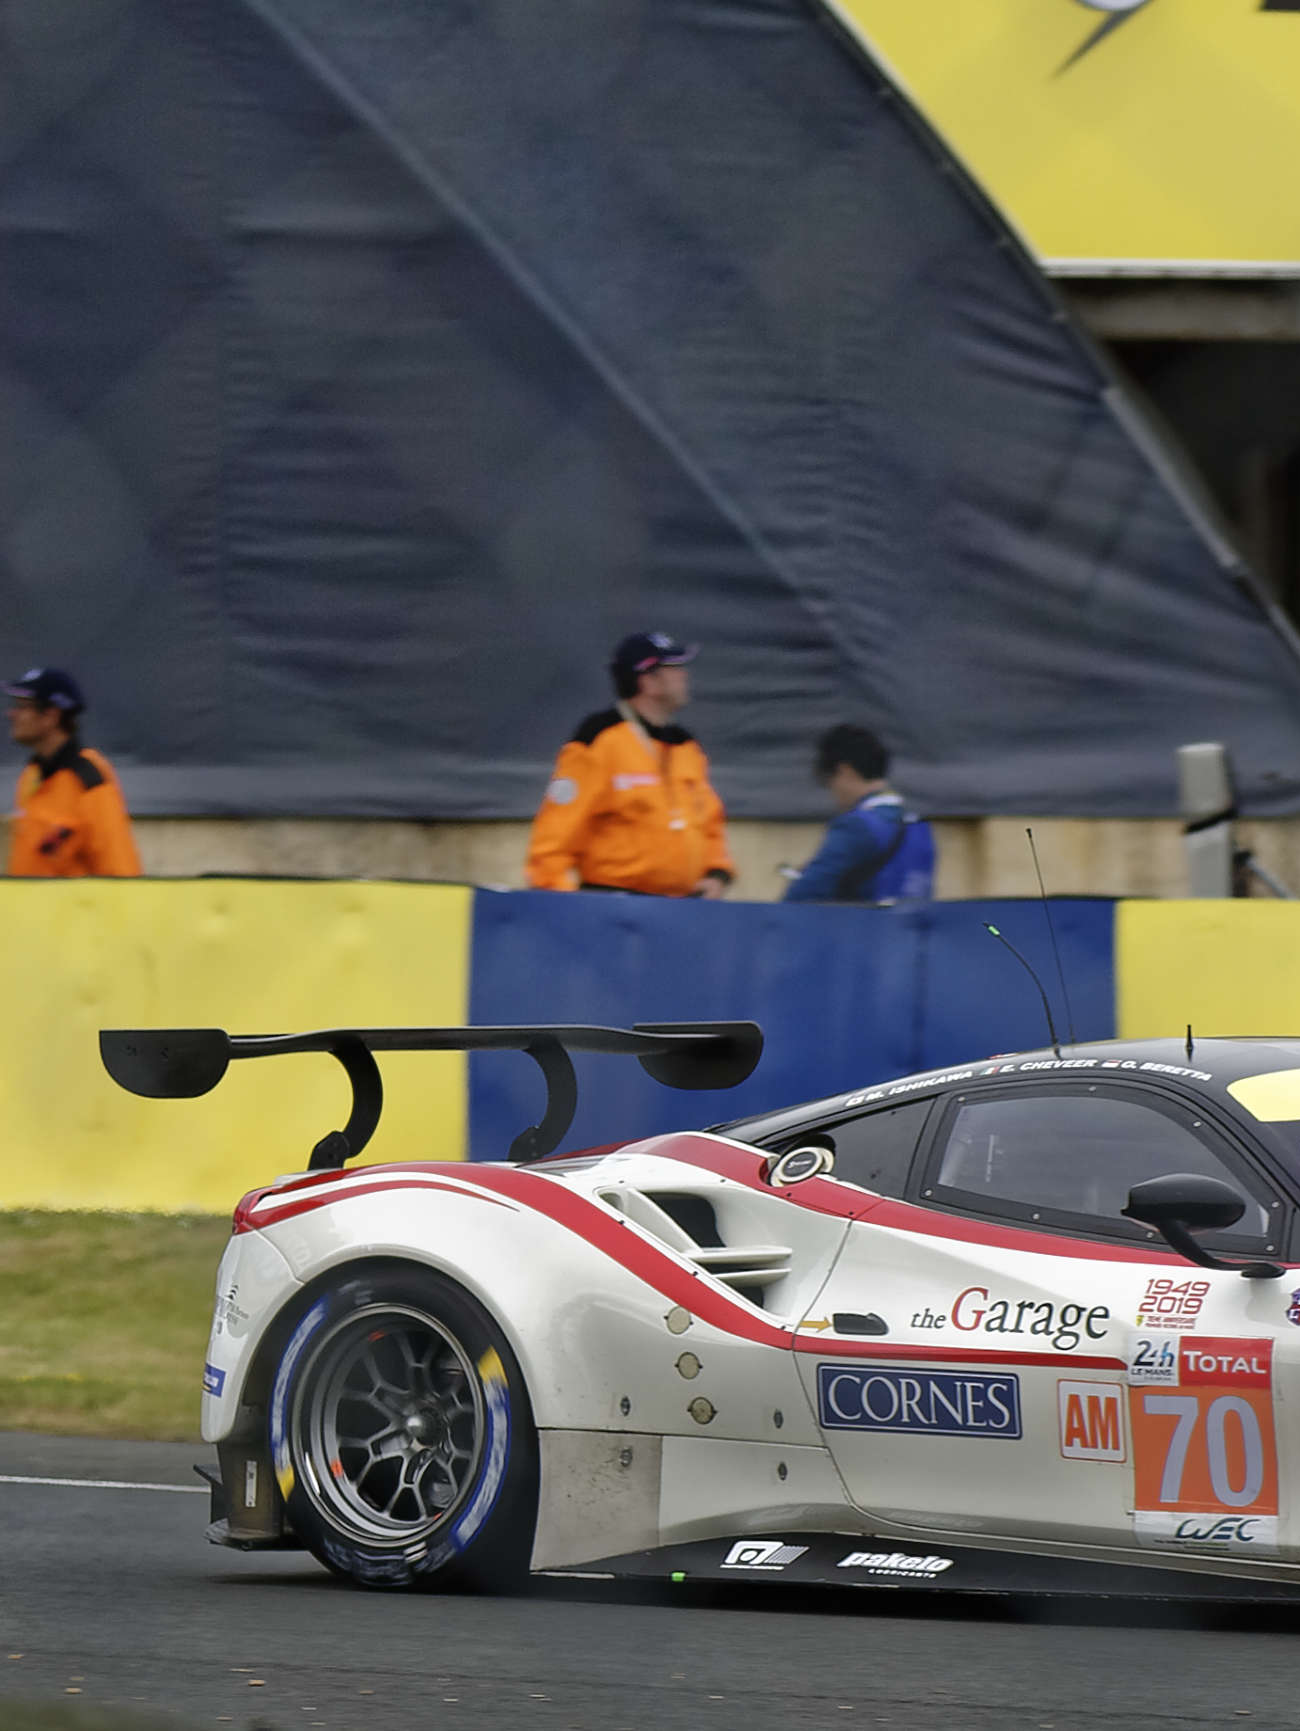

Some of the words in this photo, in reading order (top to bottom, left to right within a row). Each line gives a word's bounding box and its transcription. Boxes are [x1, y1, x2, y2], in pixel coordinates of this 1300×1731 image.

[1000, 1064, 1015, 1073] E.
[1020, 1059, 1098, 1071] CHEVEER
[1139, 1062, 1213, 1081] BERETTA
[888, 1071, 974, 1096] ISHIKAWA
[1146, 1278, 1211, 1297] 1949
[1138, 1295, 1204, 1315] 2019
[910, 1307, 947, 1329] the
[951, 1286, 1110, 1351] Garage
[1131, 1368, 1145, 1376] LE
[1182, 1350, 1267, 1375] TOTAL
[828, 1374, 1012, 1431] CORNES
[1064, 1393, 1121, 1451] AM
[1143, 1395, 1264, 1508] 70
[1174, 1517, 1262, 1542] WEC
[836, 1551, 954, 1573] pakelo
